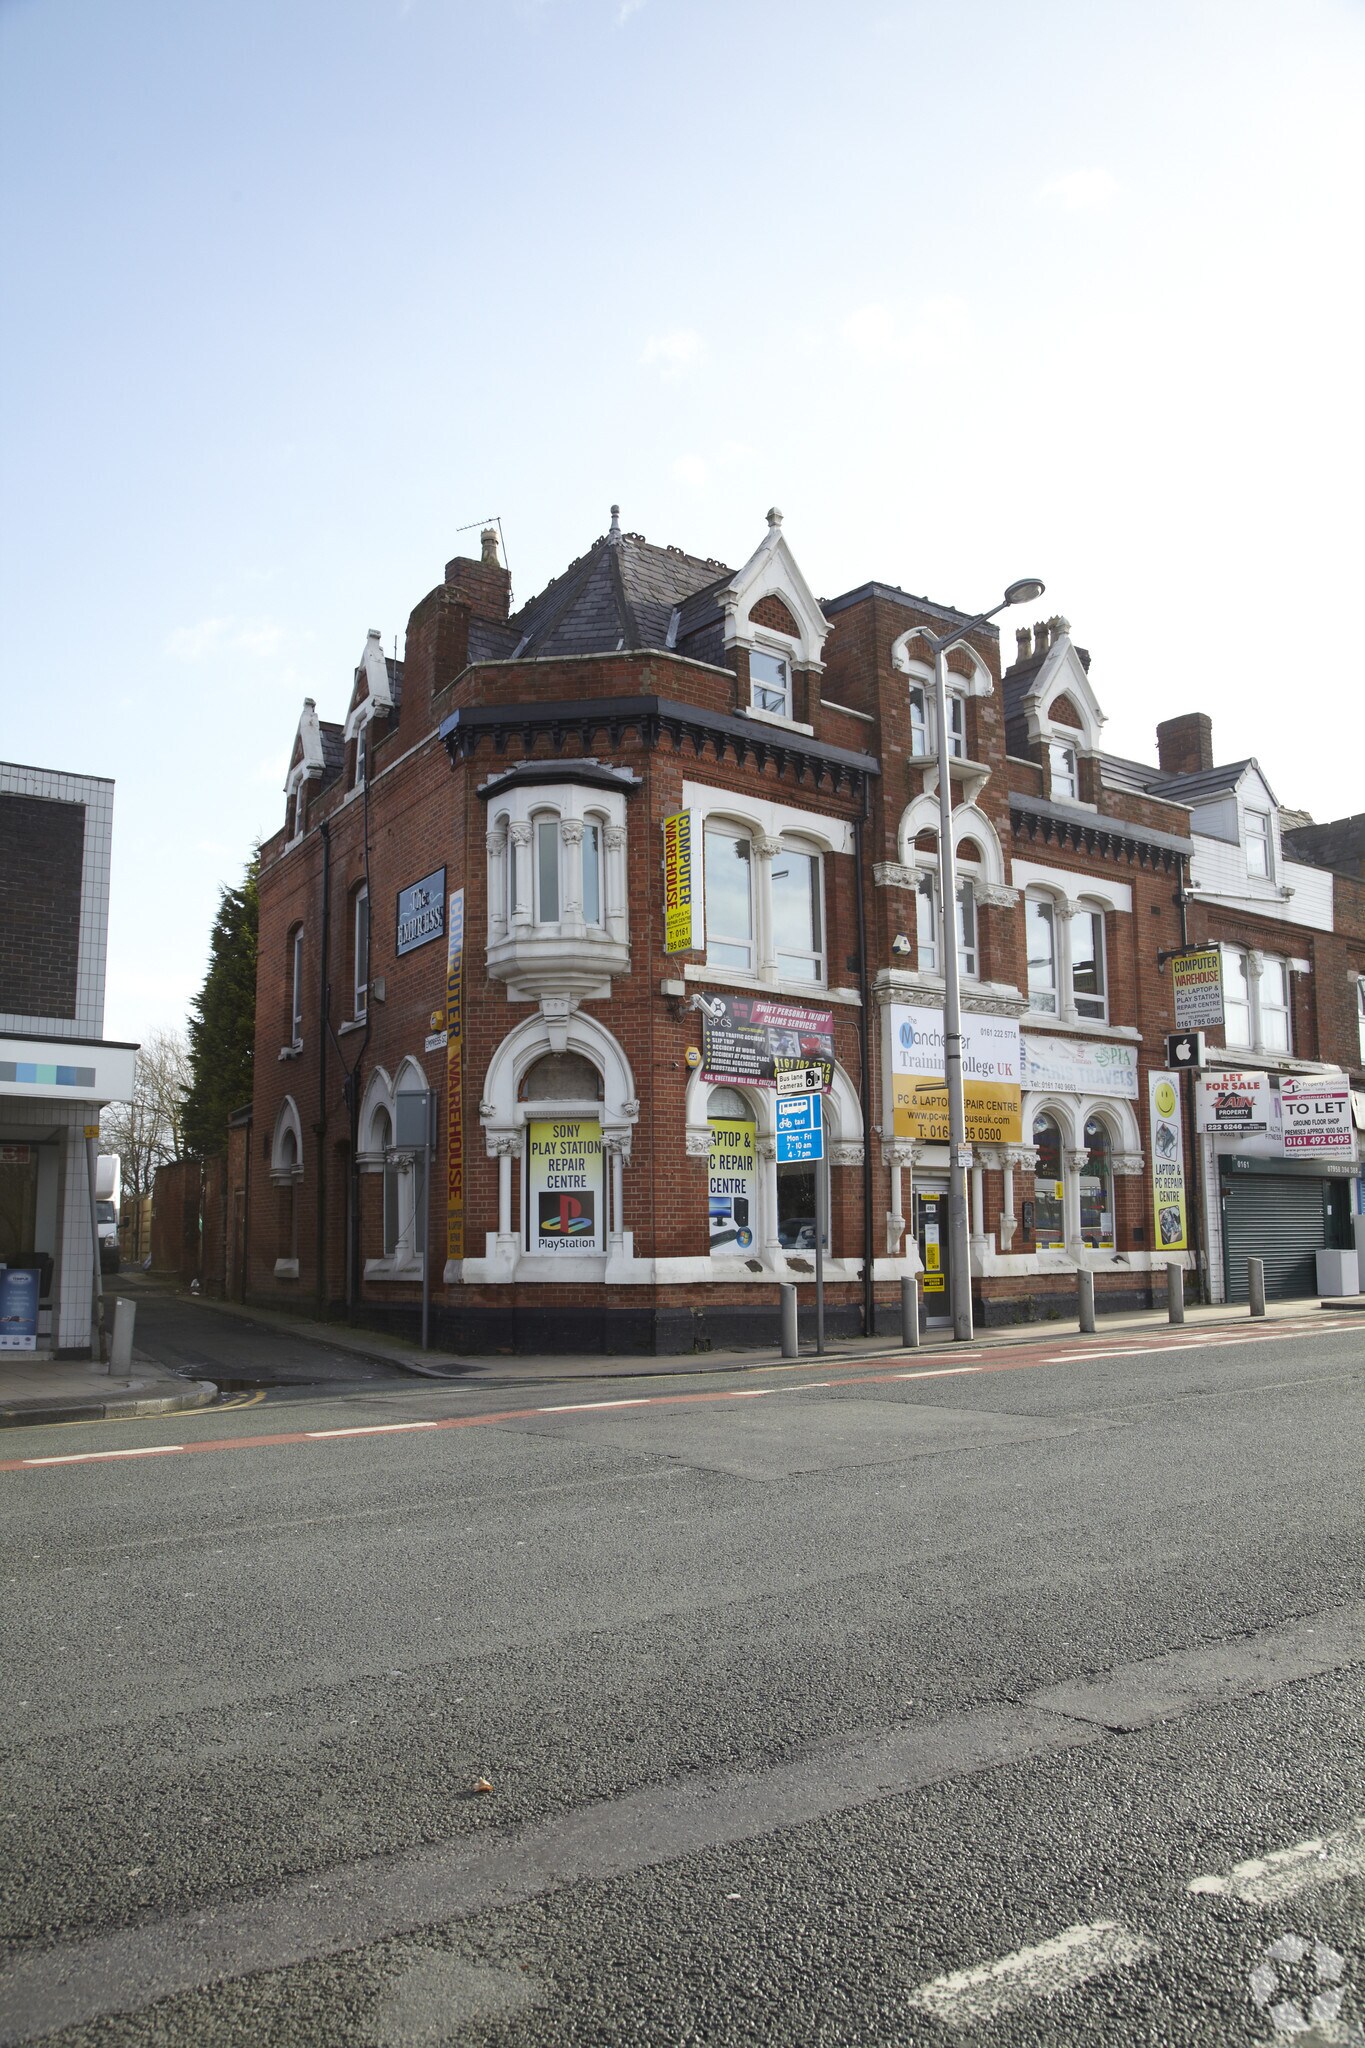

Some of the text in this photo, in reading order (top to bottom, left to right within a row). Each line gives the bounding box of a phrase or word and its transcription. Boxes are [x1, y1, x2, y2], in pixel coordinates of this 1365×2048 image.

[665, 819, 678, 912] WAREHOUSE
[678, 814, 691, 907] COMPUTER
[675, 927, 688, 937] 0161
[667, 936, 691, 950] 795 0500
[448, 896, 463, 1040] COMPUTER
[1174, 956, 1218, 973] COMPUTER
[1175, 970, 1219, 987] WAREHOUSE
[1188, 986, 1212, 995] LAPTOP
[1177, 993, 1220, 1004] PLAY STATION
[756, 1004, 776, 1014] SWIFT
[777, 1007, 807, 1019] PERSONAL
[808, 1012, 830, 1022] INJURY
[1177, 1003, 1197, 1011] REPAIR
[764, 1015, 817, 1030] CLAIMS SERVICES
[908, 1015, 917, 1024] The
[1177, 1020, 1192, 1028] 0161
[981, 1027, 993, 1036] 0161
[994, 1029, 1003, 1037] 222
[1004, 1030, 1016, 1039] 5774
[711, 1057, 759, 1068] MEDICAL NEGLIGENCE
[774, 1057, 794, 1068] 0161
[1111, 1047, 1131, 1065] PIA
[710, 1064, 761, 1075] INDUSTRIAL DEAFNESS
[900, 1050, 1013, 1077] Trainin ollege UK
[780, 1082, 803, 1090] cameras
[1206, 1082, 1260, 1091] FOR SALE
[898, 1094, 1018, 1112] PC & LAPTO PAIR CENTRE
[1213, 1096, 1255, 1108] ZAIN
[1285, 1103, 1309, 1115] TO
[1315, 1101, 1345, 1113] LET
[449, 1052, 462, 1200] WAREHOUSE
[553, 1124, 580, 1138] SONY
[918, 1124, 1001, 1140] T: 016 95 0500
[711, 1131, 751, 1147] APTOP &
[786, 1134, 799, 1142] Mon
[1286, 1135, 1350, 1145] 0161 492 0495
[532, 1140, 601, 1155] PLAY STATION
[801, 1151, 811, 1159] pm
[548, 1158, 585, 1172] REPAIR
[720, 1154, 753, 1171] REPAIR
[1156, 1164, 1181, 1175] LAPTOP &
[547, 1175, 586, 1189] CENTRE
[710, 1177, 747, 1193] CENTRE
[1155, 1177, 1183, 1189] PC REPAIR
[1159, 1191, 1180, 1202] CENTRE
[538, 1238, 595, 1251] PlayStation
